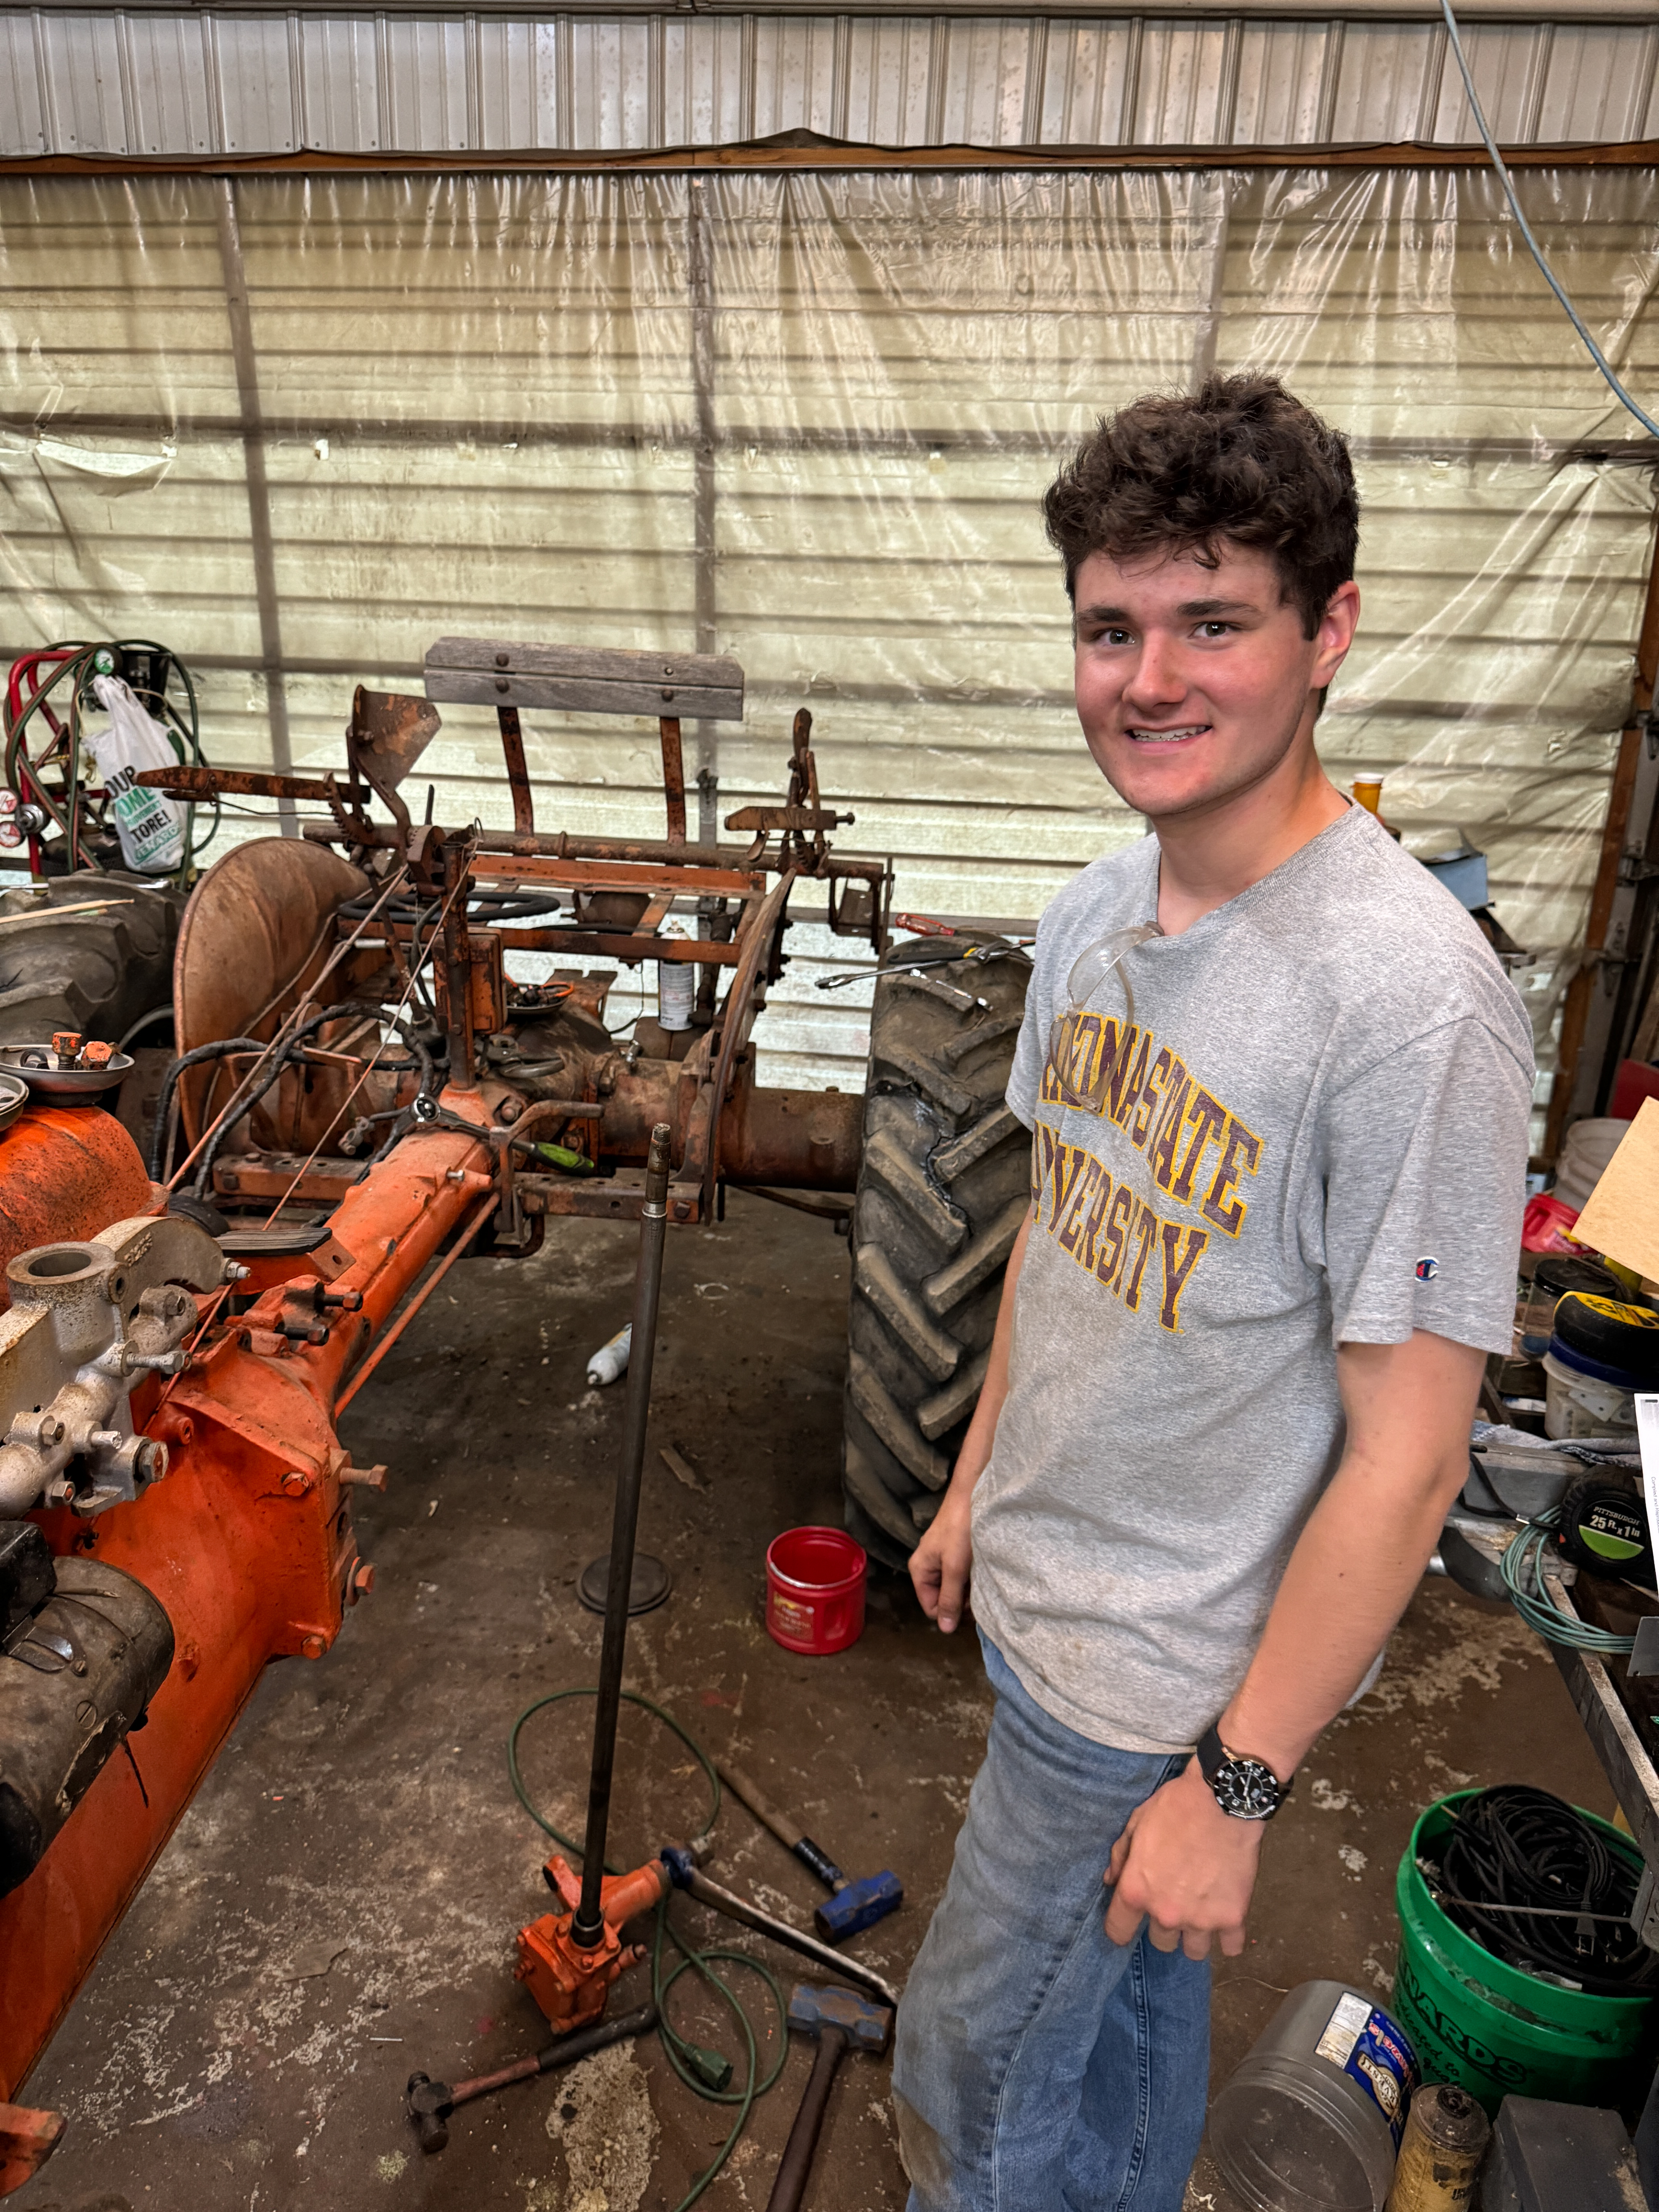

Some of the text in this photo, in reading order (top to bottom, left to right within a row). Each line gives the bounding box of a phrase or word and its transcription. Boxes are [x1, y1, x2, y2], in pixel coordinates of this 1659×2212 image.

[105, 766, 136, 799] OUR
[115, 786, 156, 816] OME
[129, 809, 172, 843] TORE!
[1590, 1515, 1607, 1529] 25
[1624, 1526, 1630, 1537] 1
[1593, 1506, 1641, 1526] PITTSBURGH
[1400, 1960, 1528, 2085] NARDS
